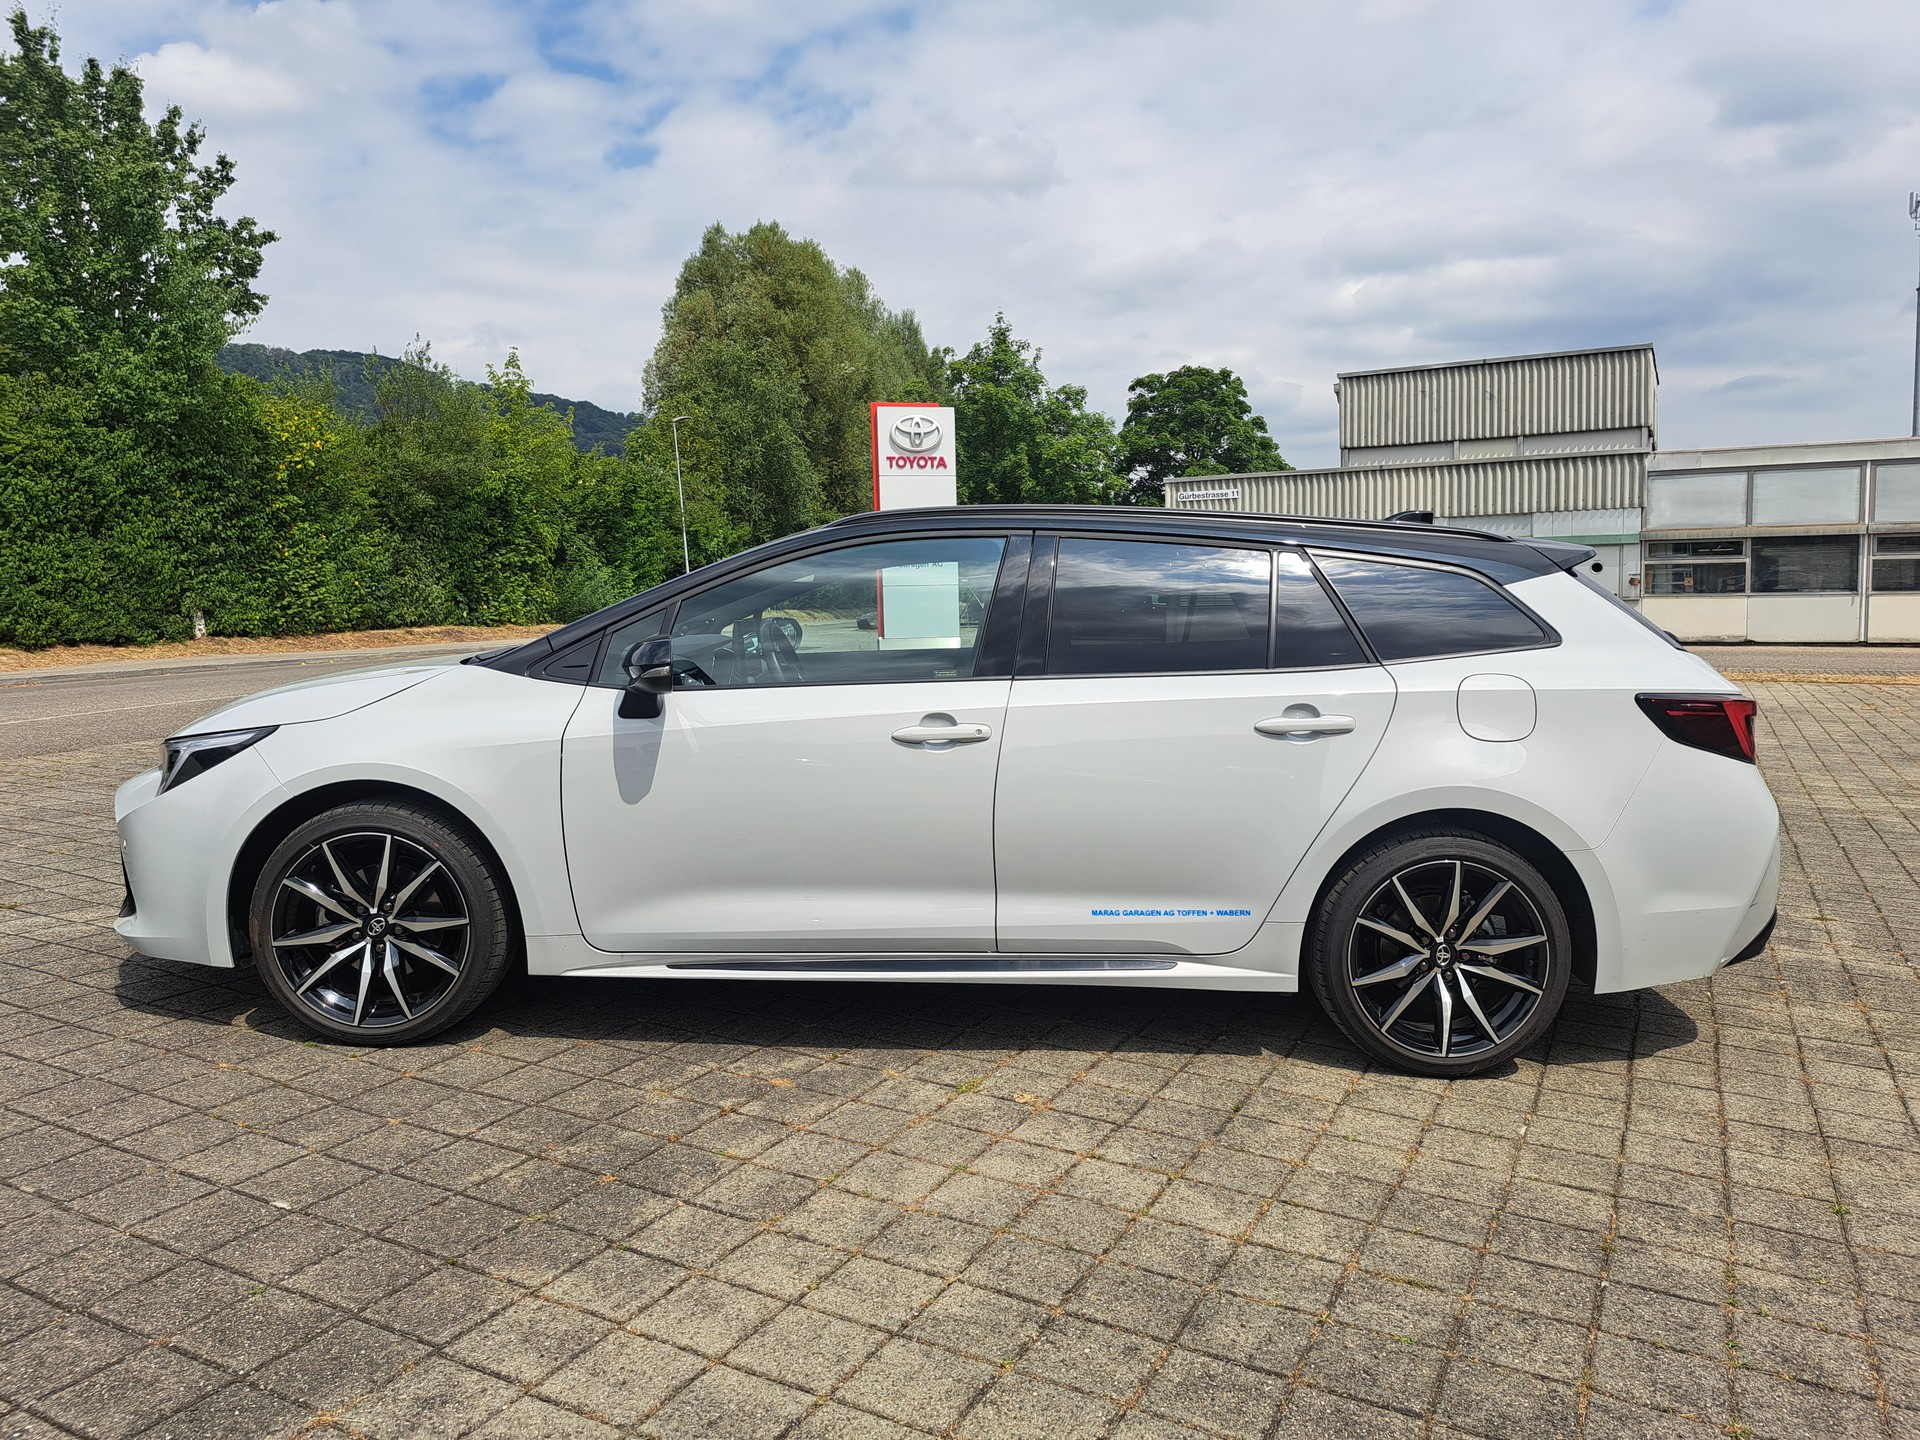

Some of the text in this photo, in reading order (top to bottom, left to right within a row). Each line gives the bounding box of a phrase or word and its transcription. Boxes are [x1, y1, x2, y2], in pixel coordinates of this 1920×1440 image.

[886, 456, 948, 470] TOYOTA
[1179, 491, 1229, 500] Gürbestrasse
[1091, 909, 1121, 917] MARAG
[1122, 909, 1161, 917] GARAGEN
[1163, 909, 1175, 917] AG
[1177, 909, 1207, 917] TOFFEN
[1216, 909, 1251, 917] WABERN
